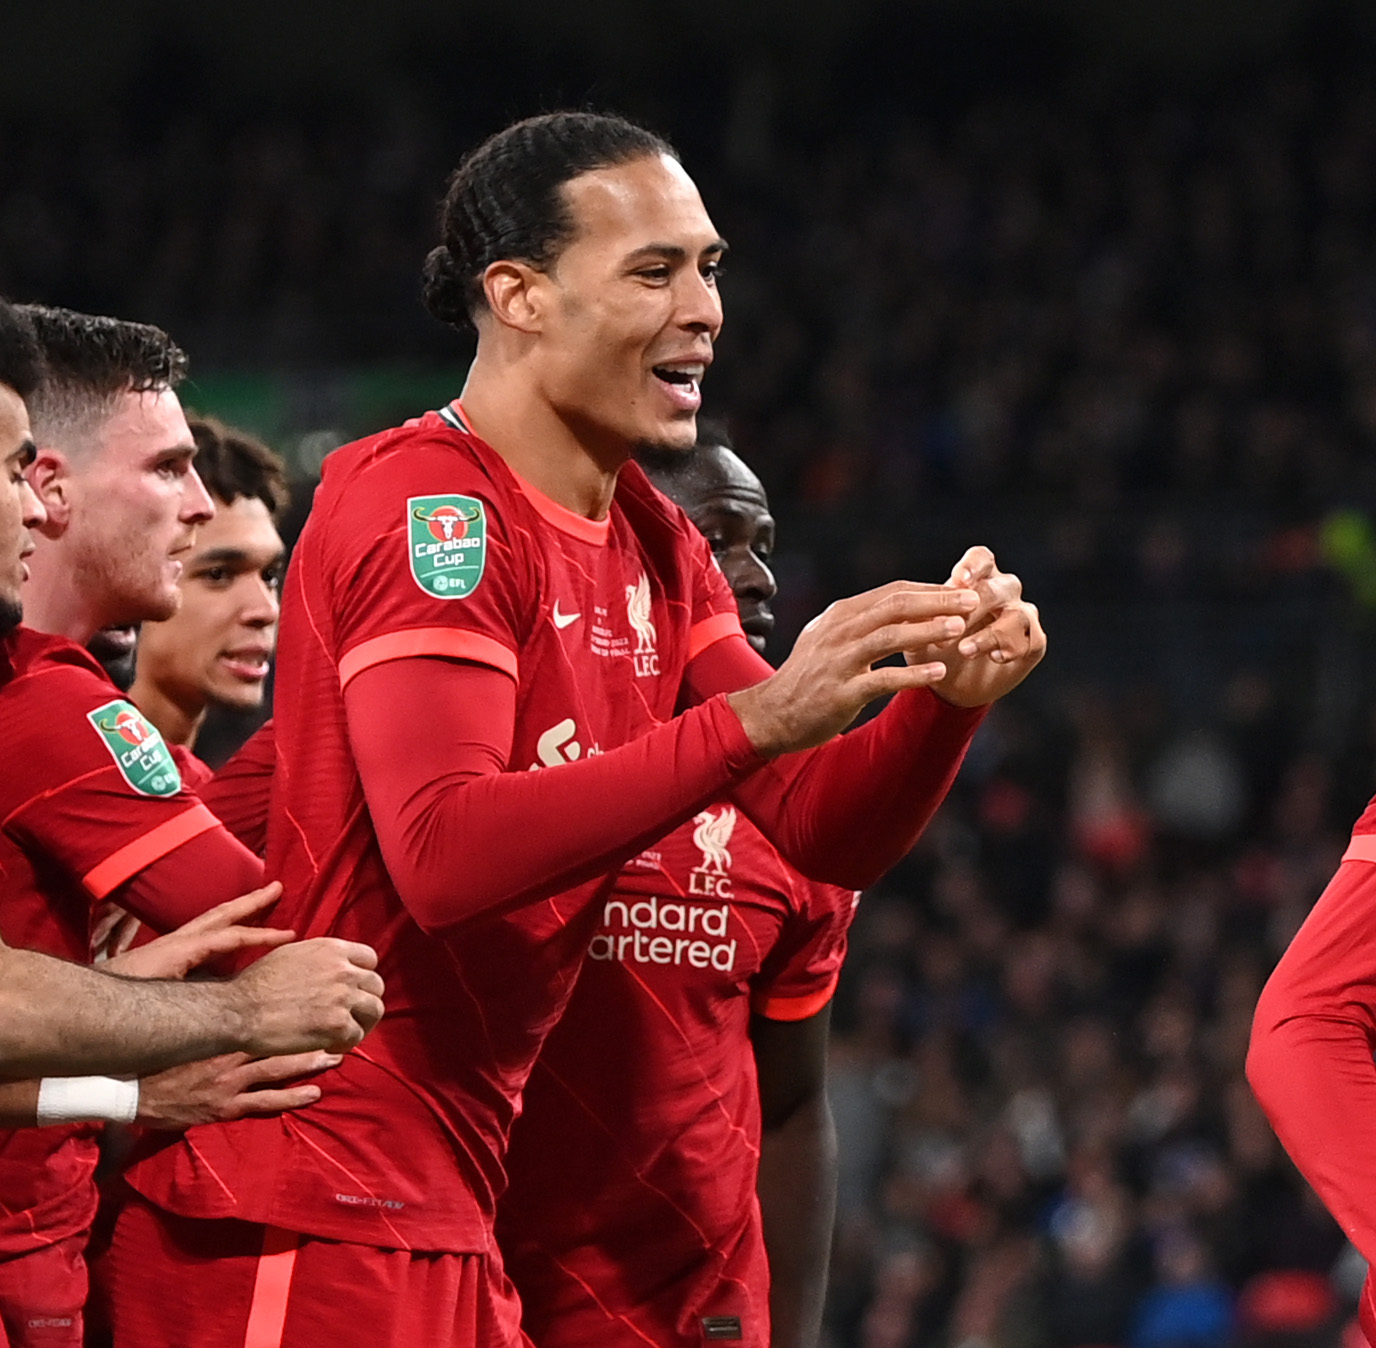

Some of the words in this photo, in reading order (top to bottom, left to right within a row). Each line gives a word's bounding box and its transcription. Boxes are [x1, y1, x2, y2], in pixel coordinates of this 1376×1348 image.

[415, 537, 480, 558] Carabao
[433, 553, 465, 568] Cup
[603, 895, 729, 937] ndard
[587, 929, 737, 972] artered
